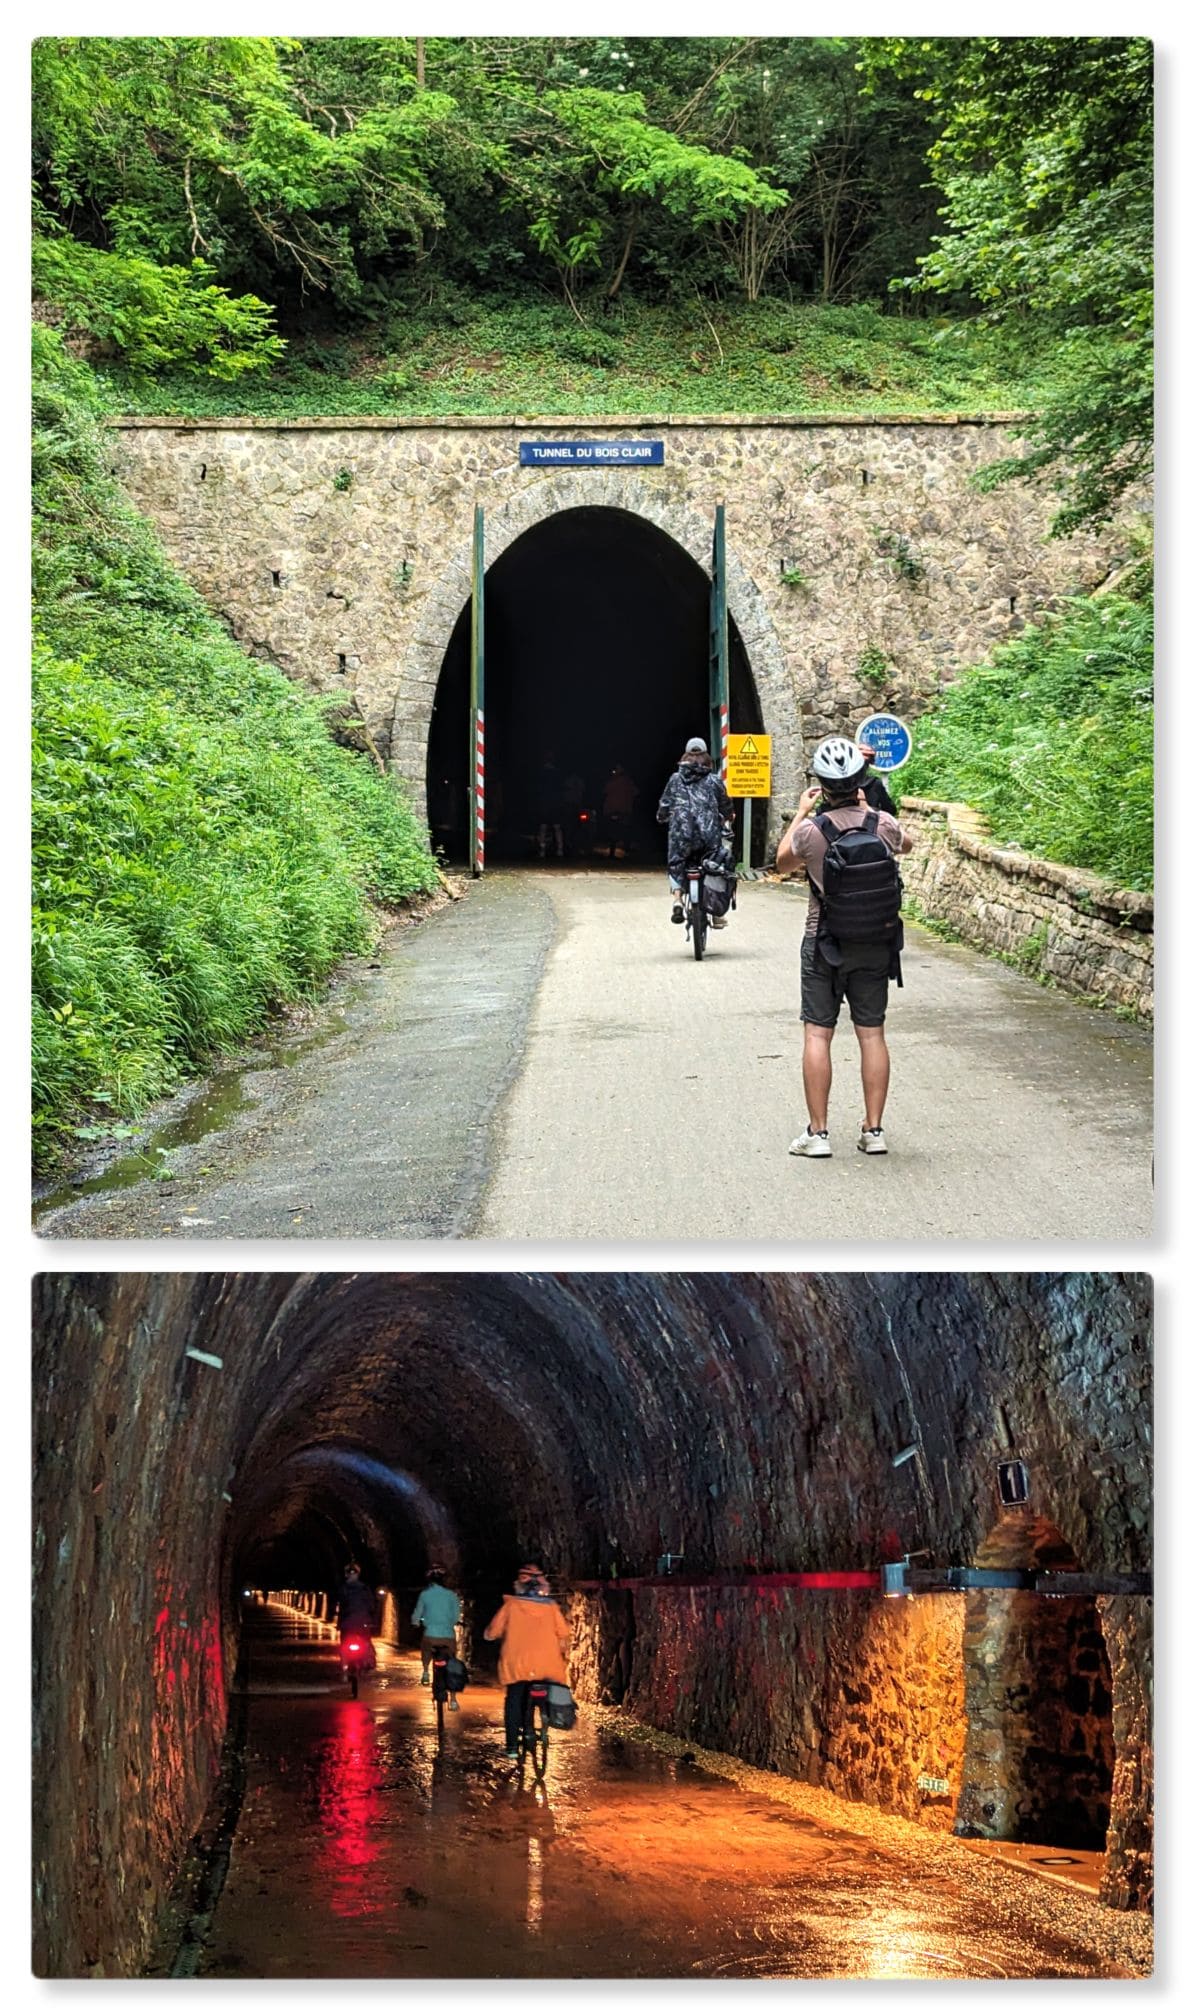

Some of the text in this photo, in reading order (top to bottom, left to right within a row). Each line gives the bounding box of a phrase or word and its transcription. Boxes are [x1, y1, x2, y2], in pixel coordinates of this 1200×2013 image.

[532, 448, 652, 458] TUNNEL DU BOIS CLAIR
[869, 727, 899, 735] ALLUMEZ
[878, 739, 890, 747] VOS
[1007, 1466, 1017, 1499] 1
